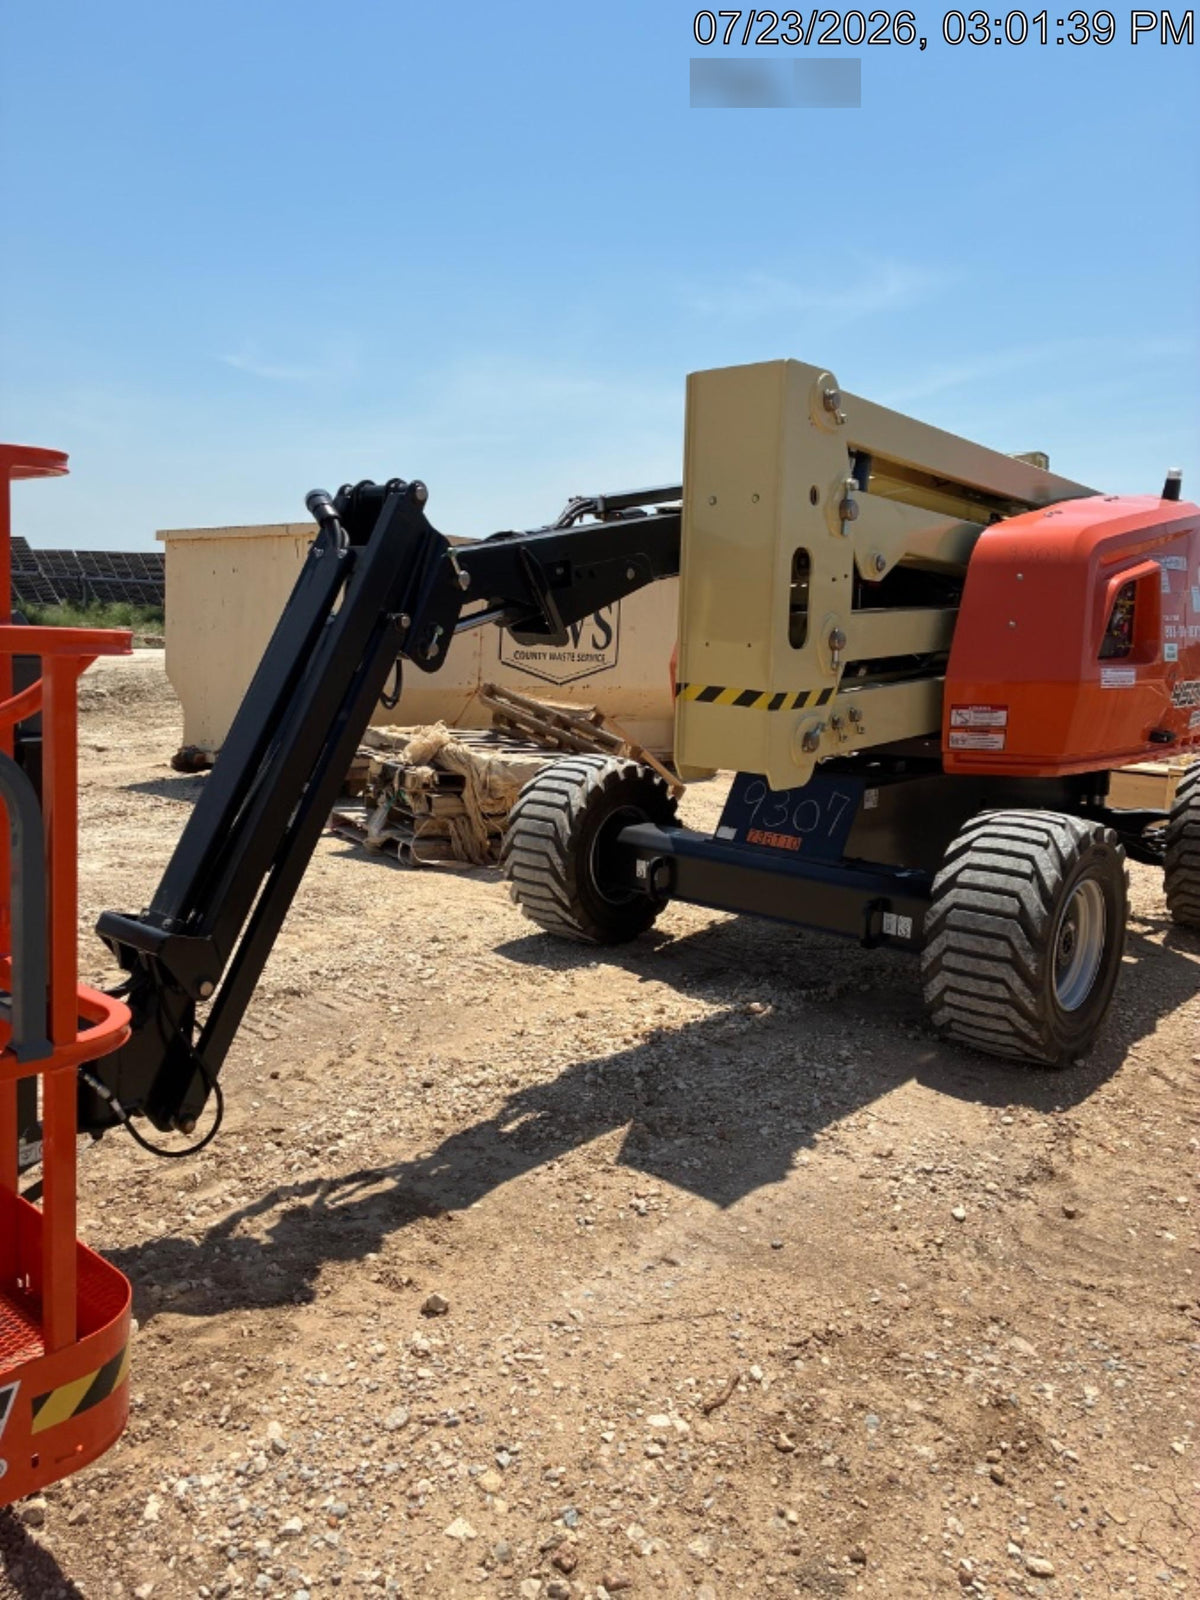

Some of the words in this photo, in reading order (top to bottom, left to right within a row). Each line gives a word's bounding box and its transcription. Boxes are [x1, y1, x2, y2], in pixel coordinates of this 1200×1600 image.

[513, 650, 548, 661] COUNTY
[549, 651, 575, 662] WASTE
[577, 653, 605, 663] SERVICE
[744, 780, 851, 837] 9307
